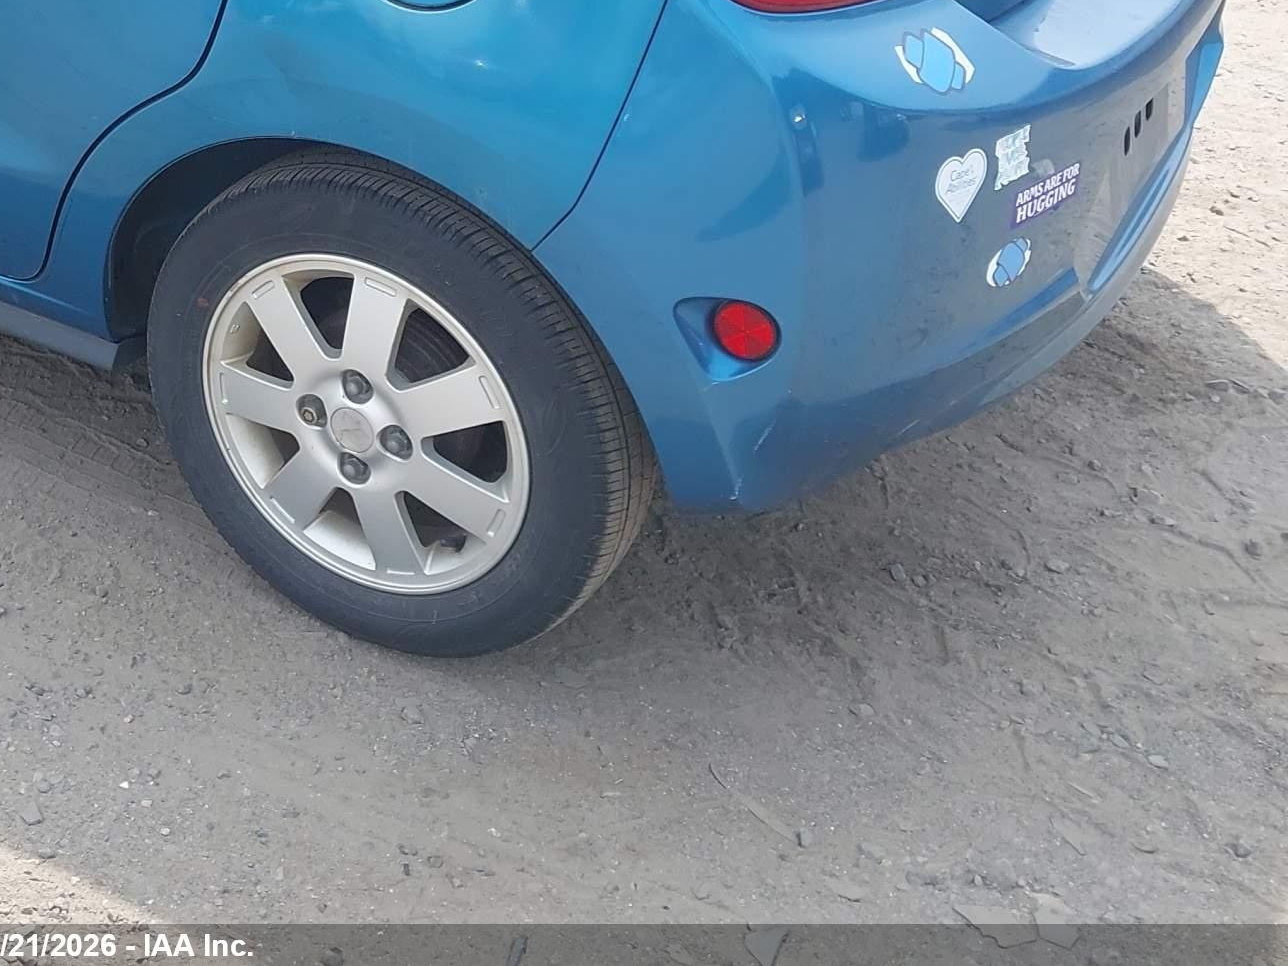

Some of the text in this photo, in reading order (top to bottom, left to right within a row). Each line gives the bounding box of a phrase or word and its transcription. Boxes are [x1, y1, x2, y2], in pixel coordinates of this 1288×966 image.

[1015, 162, 1081, 207] ARMS ARE FOR
[1016, 179, 1076, 223] HUGGING
